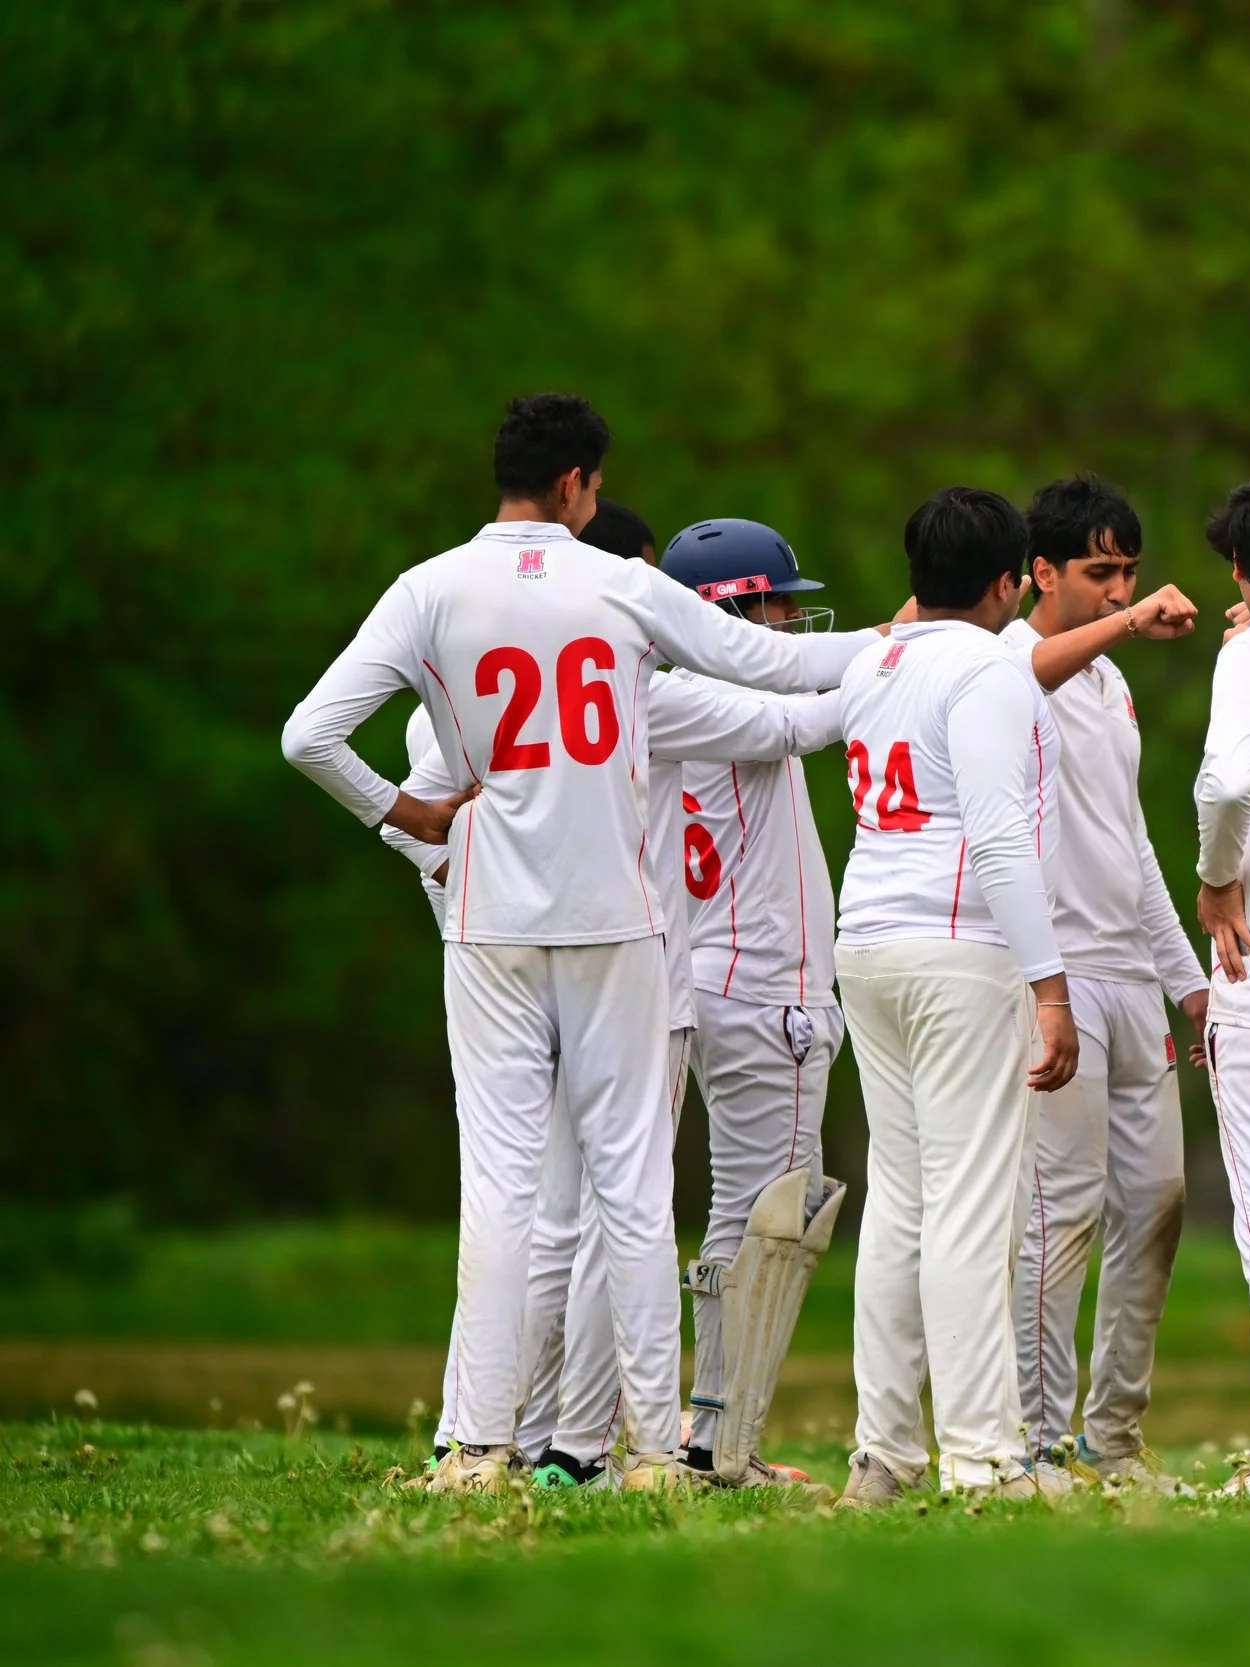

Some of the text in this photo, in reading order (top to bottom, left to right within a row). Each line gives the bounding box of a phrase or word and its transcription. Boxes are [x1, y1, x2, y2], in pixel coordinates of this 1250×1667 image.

[517, 549, 546, 573] H
[517, 571, 547, 580] CRICKET
[716, 582, 738, 595] GM
[475, 636, 621, 771] 26
[845, 739, 933, 832] 24
